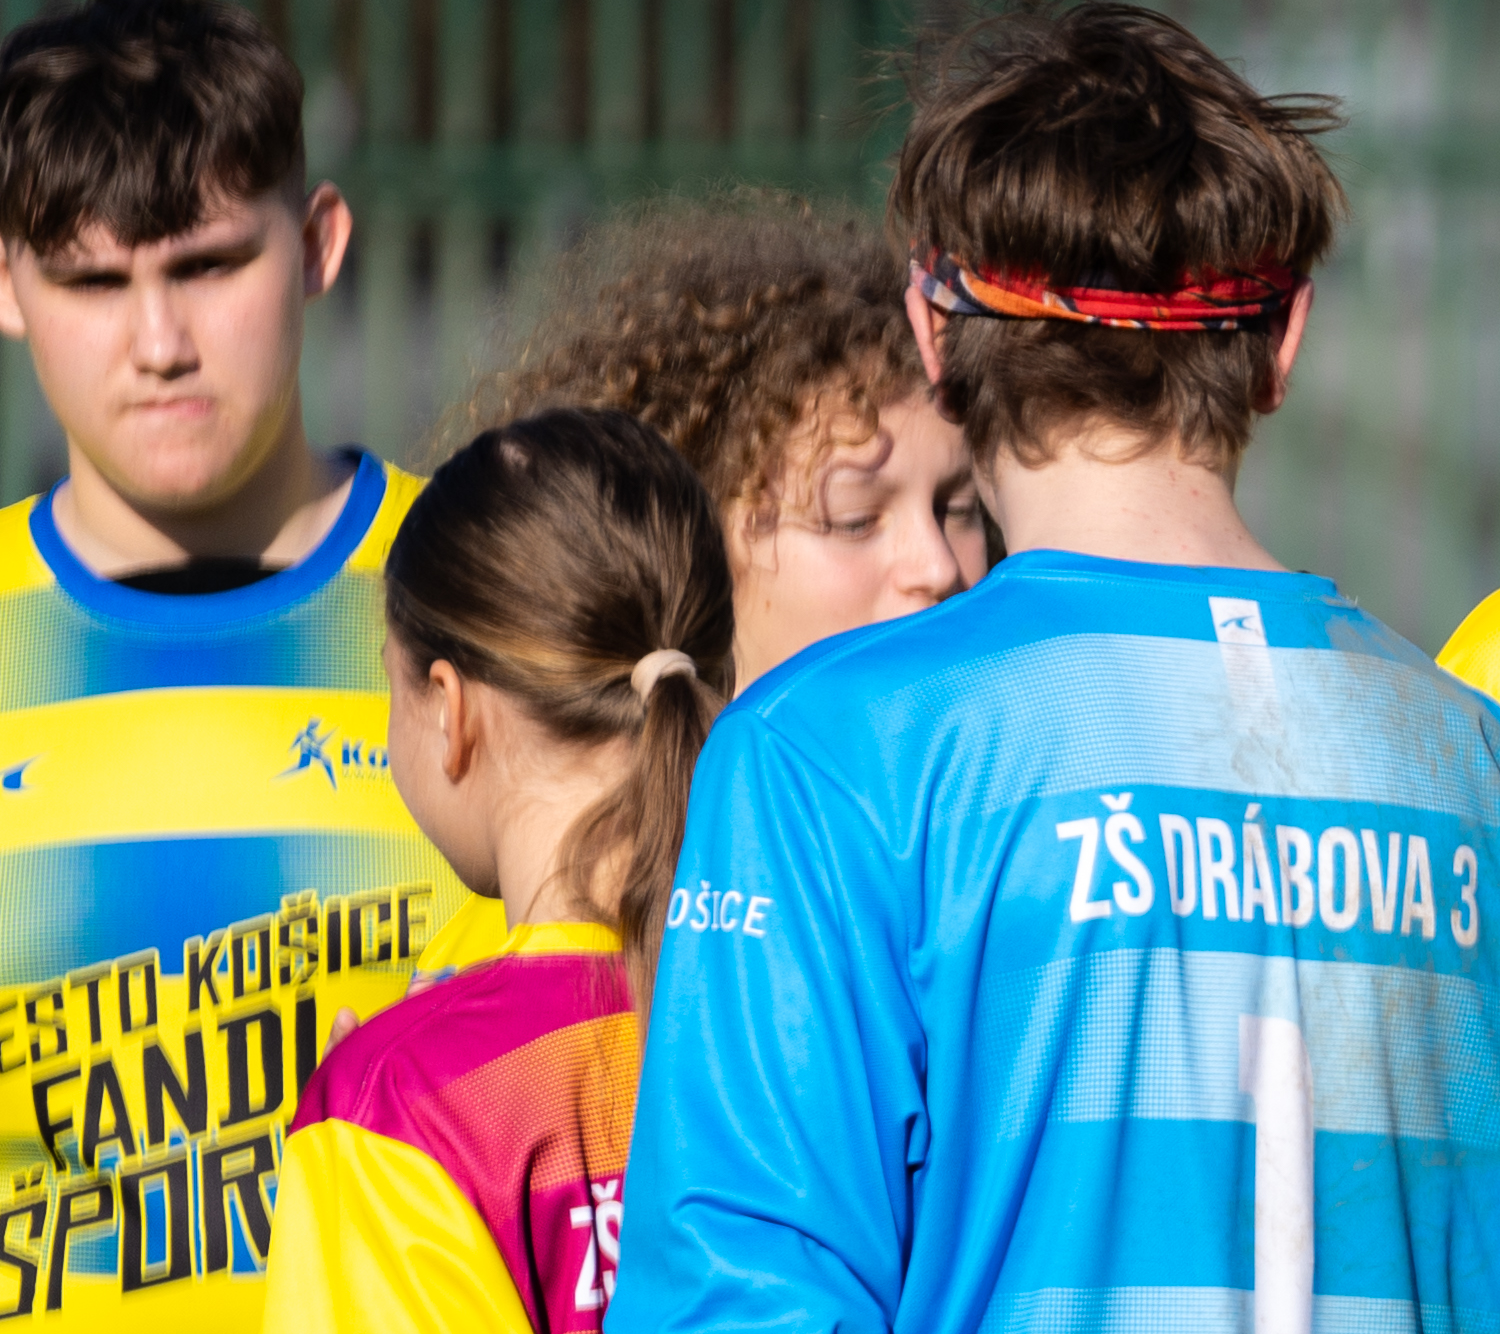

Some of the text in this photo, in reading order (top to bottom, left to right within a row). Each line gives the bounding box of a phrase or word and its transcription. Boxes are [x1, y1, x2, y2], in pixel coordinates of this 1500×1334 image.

[1055, 792, 1480, 949] ZŠ DRÁBOVA 3
